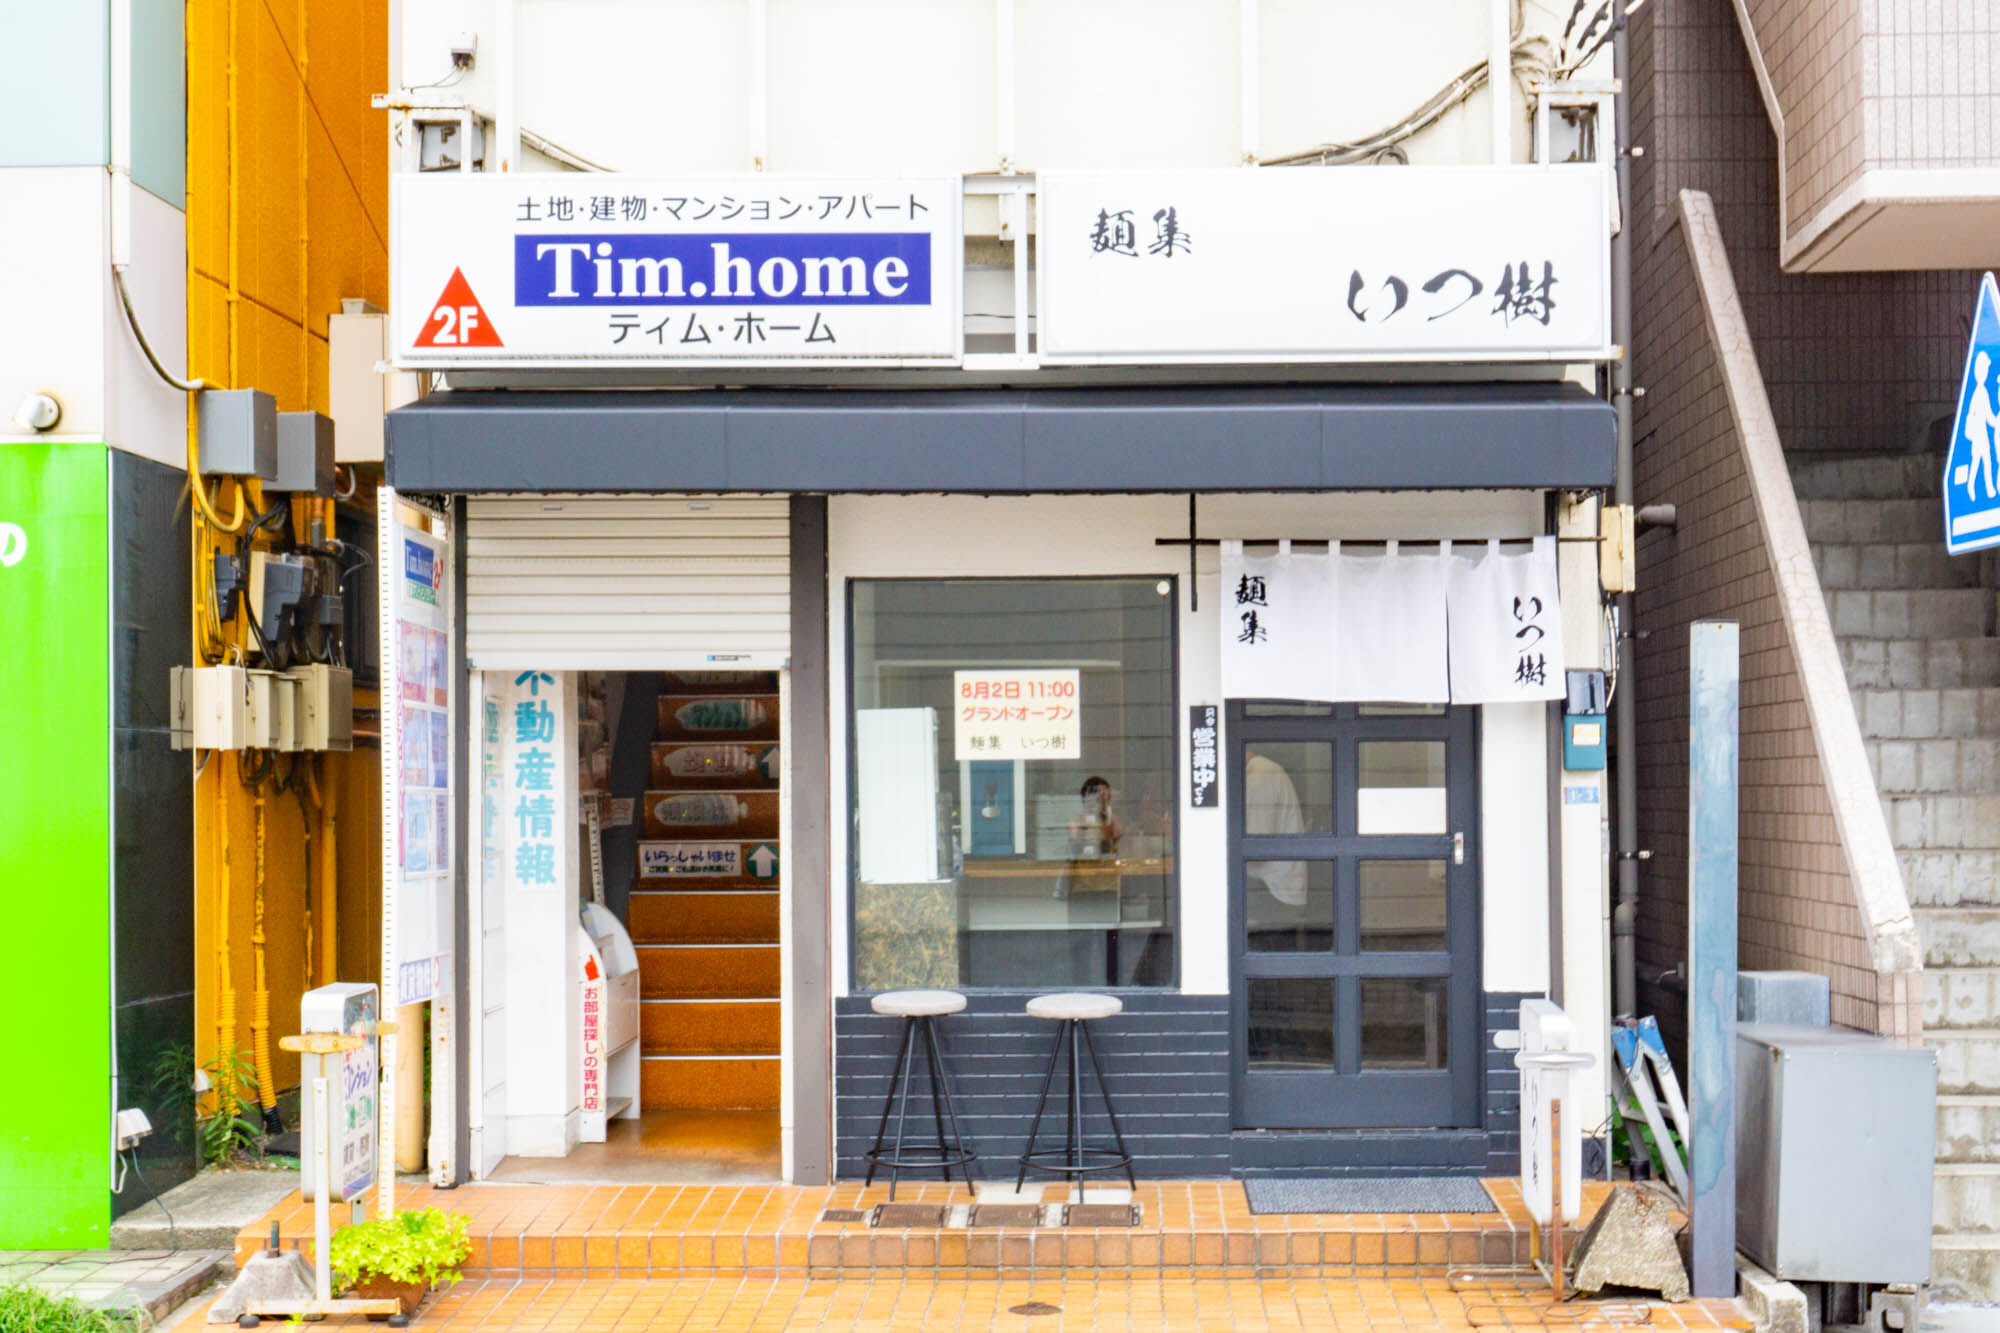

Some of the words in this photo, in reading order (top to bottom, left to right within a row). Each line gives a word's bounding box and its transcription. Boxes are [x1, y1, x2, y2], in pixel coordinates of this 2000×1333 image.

[536, 242, 910, 298] Tim.home
[1346, 260, 1560, 328] いつ樹
[433, 305, 479, 343] 2F
[1513, 596, 1548, 687] いつ樹
[960, 680, 1021, 700] 8月2日
[1028, 680, 1075, 698] 11:00
[514, 670, 556, 885] 不動産情報
[583, 987, 599, 1110] お部屋探しの専門店
